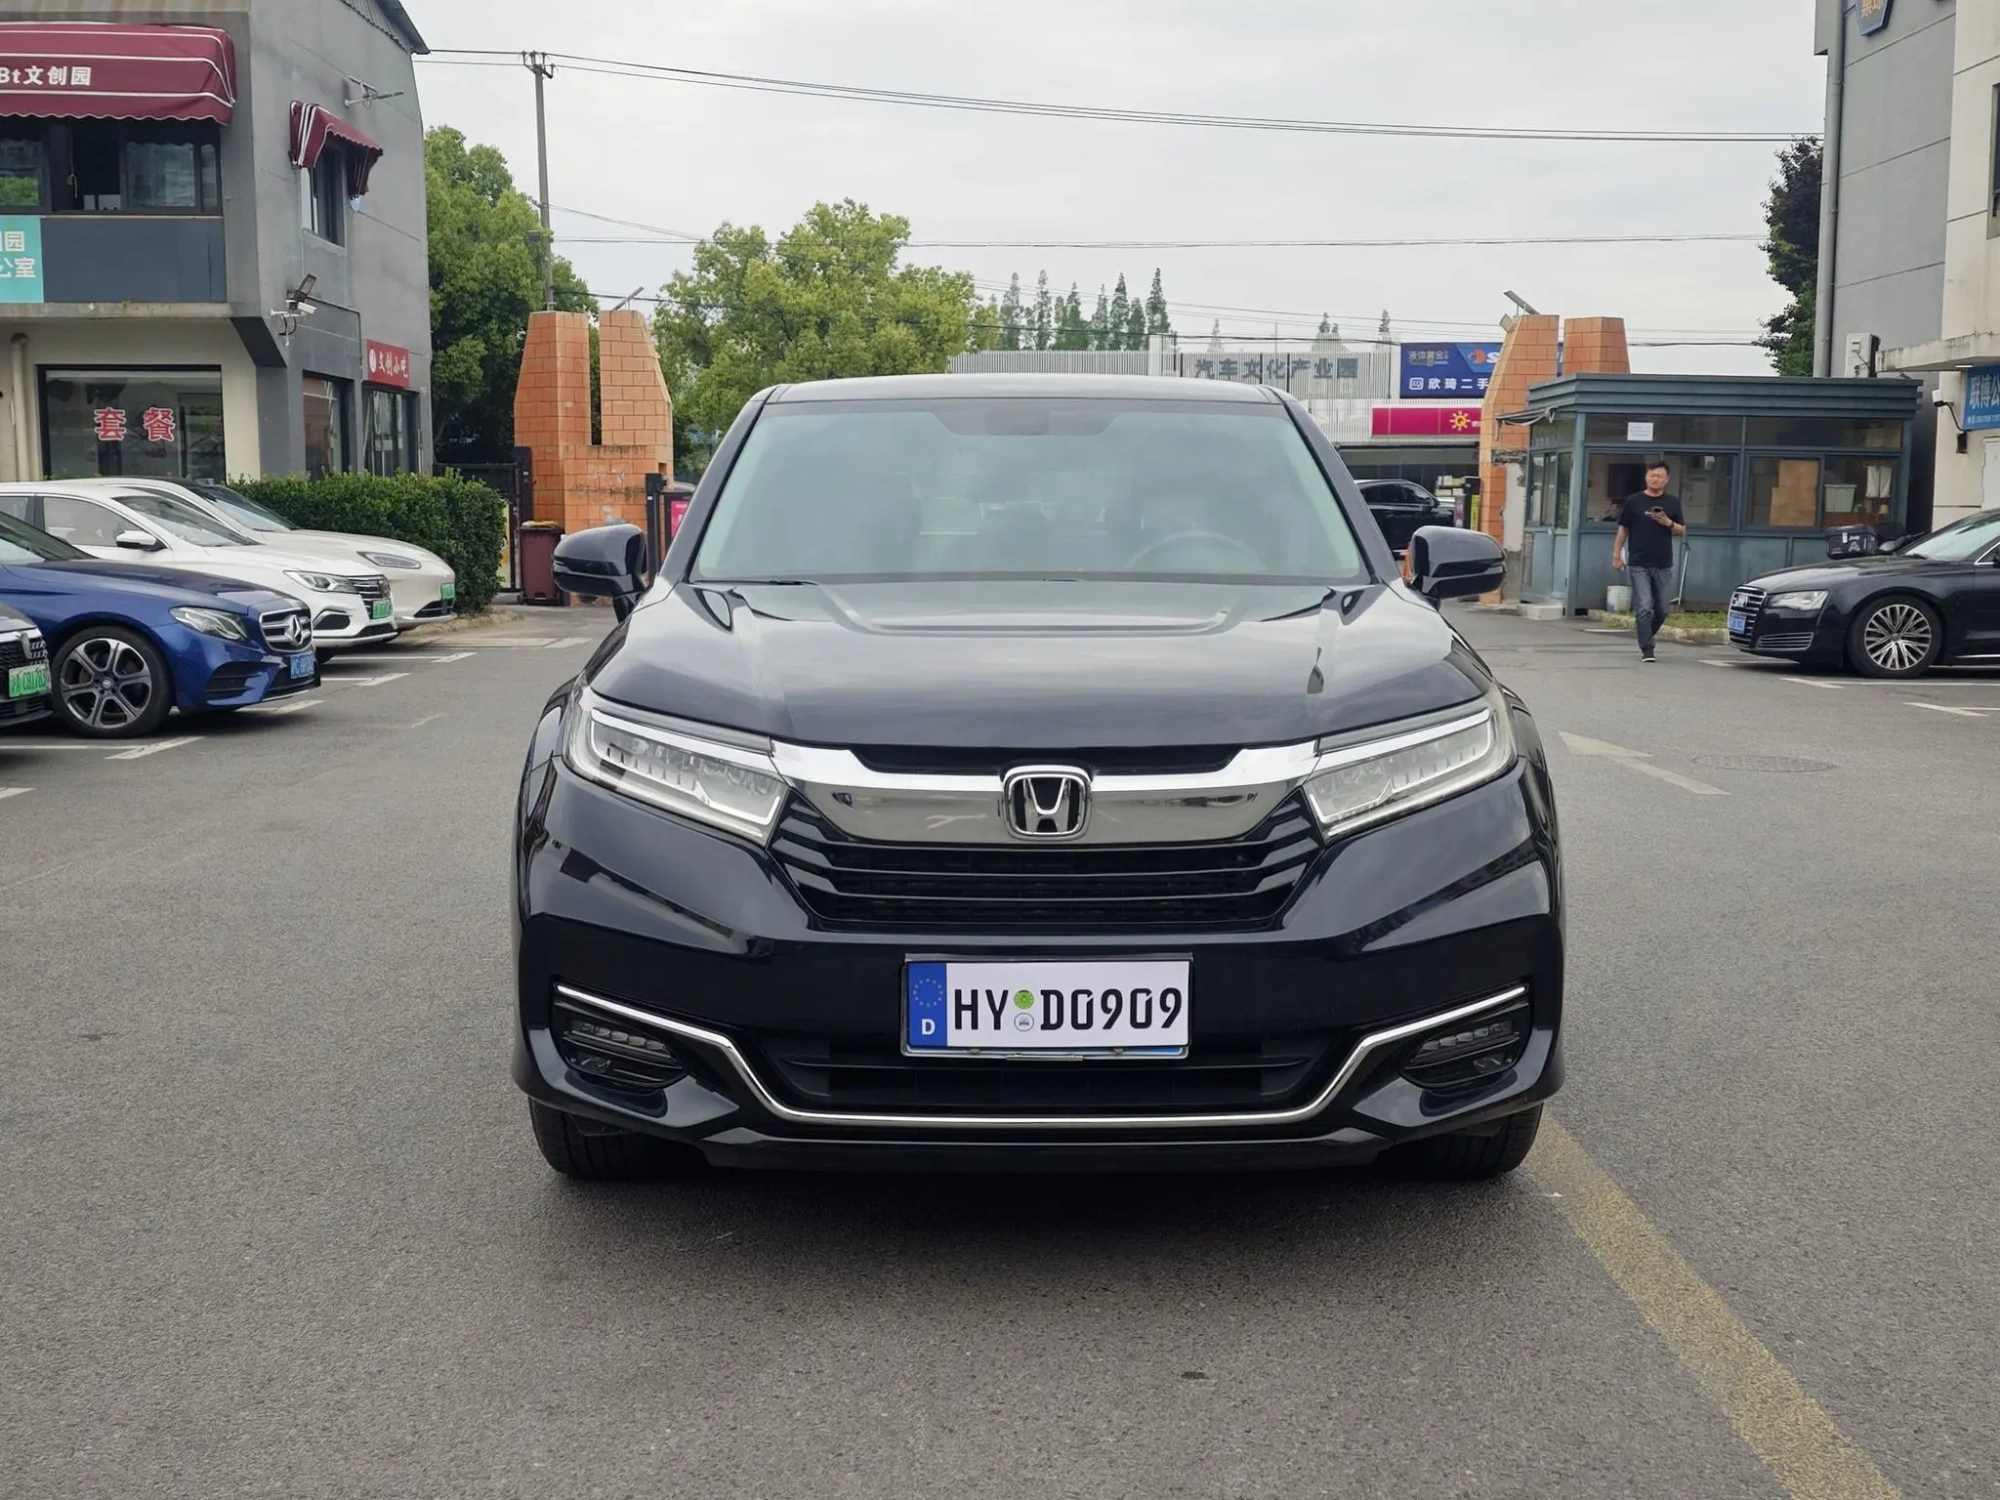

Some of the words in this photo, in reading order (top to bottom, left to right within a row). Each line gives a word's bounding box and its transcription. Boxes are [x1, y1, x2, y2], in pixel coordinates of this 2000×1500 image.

[94, 407, 175, 442] 套餐
[921, 1018, 936, 1035] D
[954, 989, 1009, 1030] HY
[1040, 988, 1182, 1030] D0909
